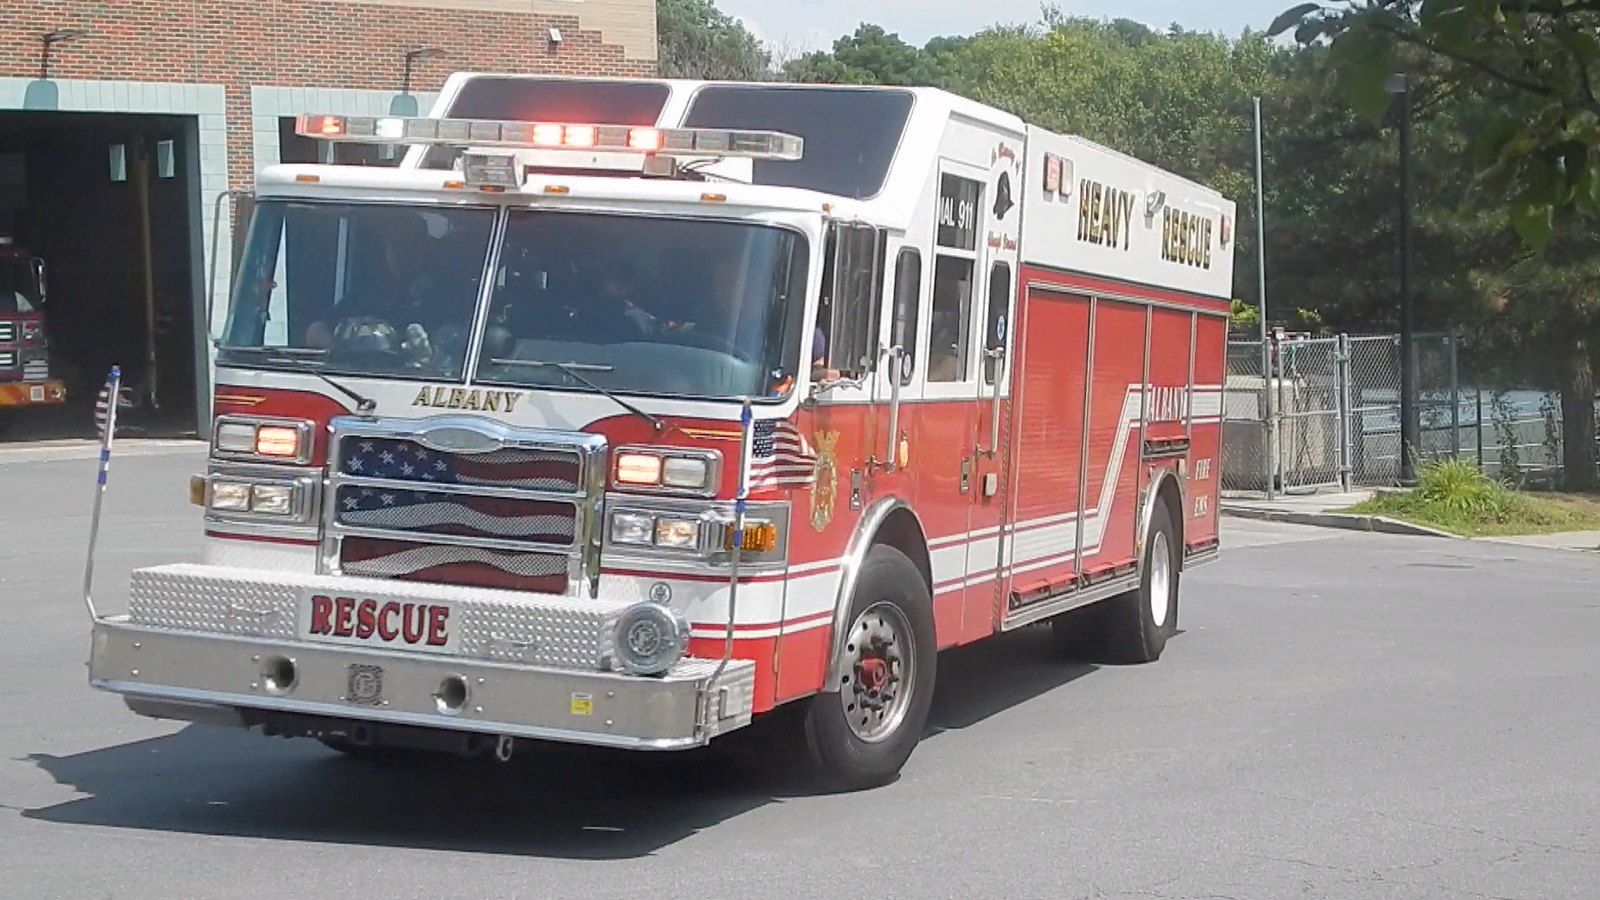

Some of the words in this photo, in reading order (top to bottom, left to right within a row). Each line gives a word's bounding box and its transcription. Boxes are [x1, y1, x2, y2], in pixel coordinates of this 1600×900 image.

[958, 200, 973, 230] 911
[1077, 178, 1136, 251] HEAVY
[1162, 205, 1212, 270] RESCUE
[411, 385, 524, 412] ALBANY
[309, 595, 450, 646] RESCUE
